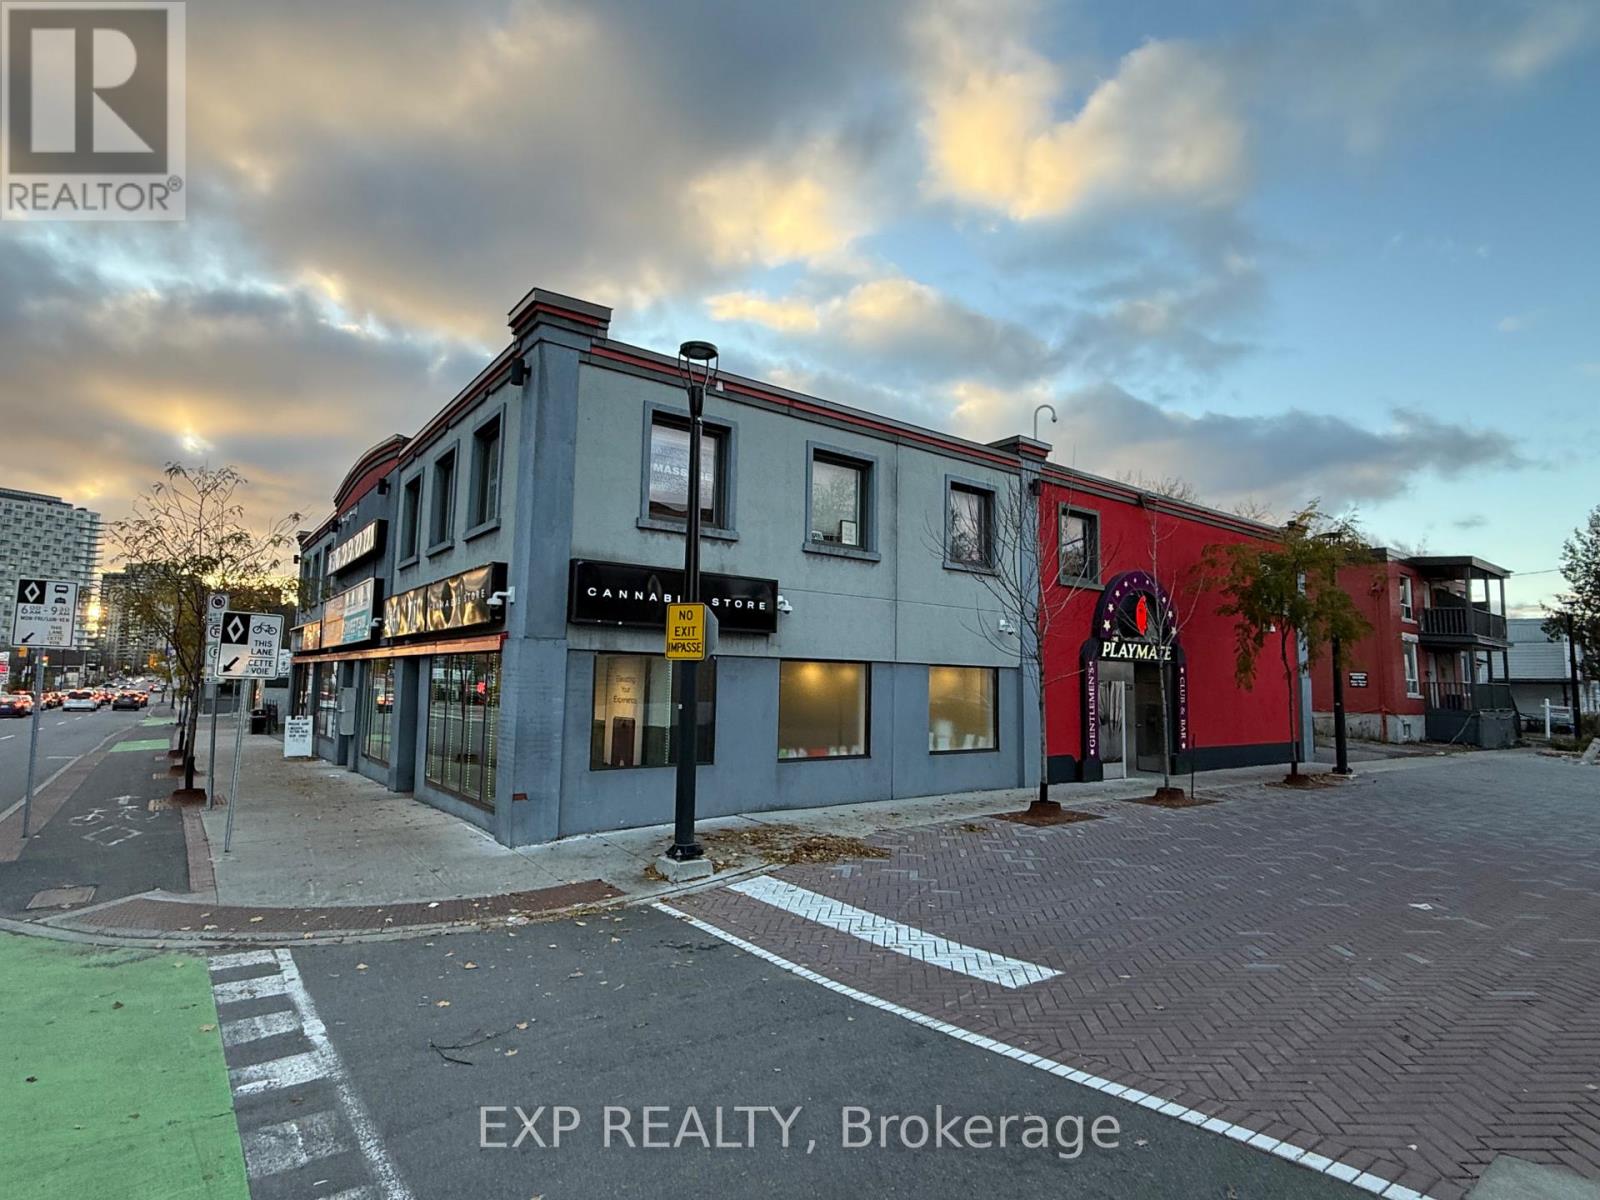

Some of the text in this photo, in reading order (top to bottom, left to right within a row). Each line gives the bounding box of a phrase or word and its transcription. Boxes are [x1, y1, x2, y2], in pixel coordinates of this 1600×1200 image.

[653, 463, 713, 482] MASSE
[587, 587, 766, 610] CANNABI STORE
[21, 605, 28, 614] 6
[51, 606, 57, 615] 9
[678, 610, 693, 621] NO
[674, 626, 697, 637] EXIT
[251, 648, 273, 656] LANE
[668, 641, 701, 653] IMPASSE
[248, 659, 273, 667] CETTE
[251, 667, 270, 675] VOIE
[1088, 667, 1096, 748] GENTLEMEN'S
